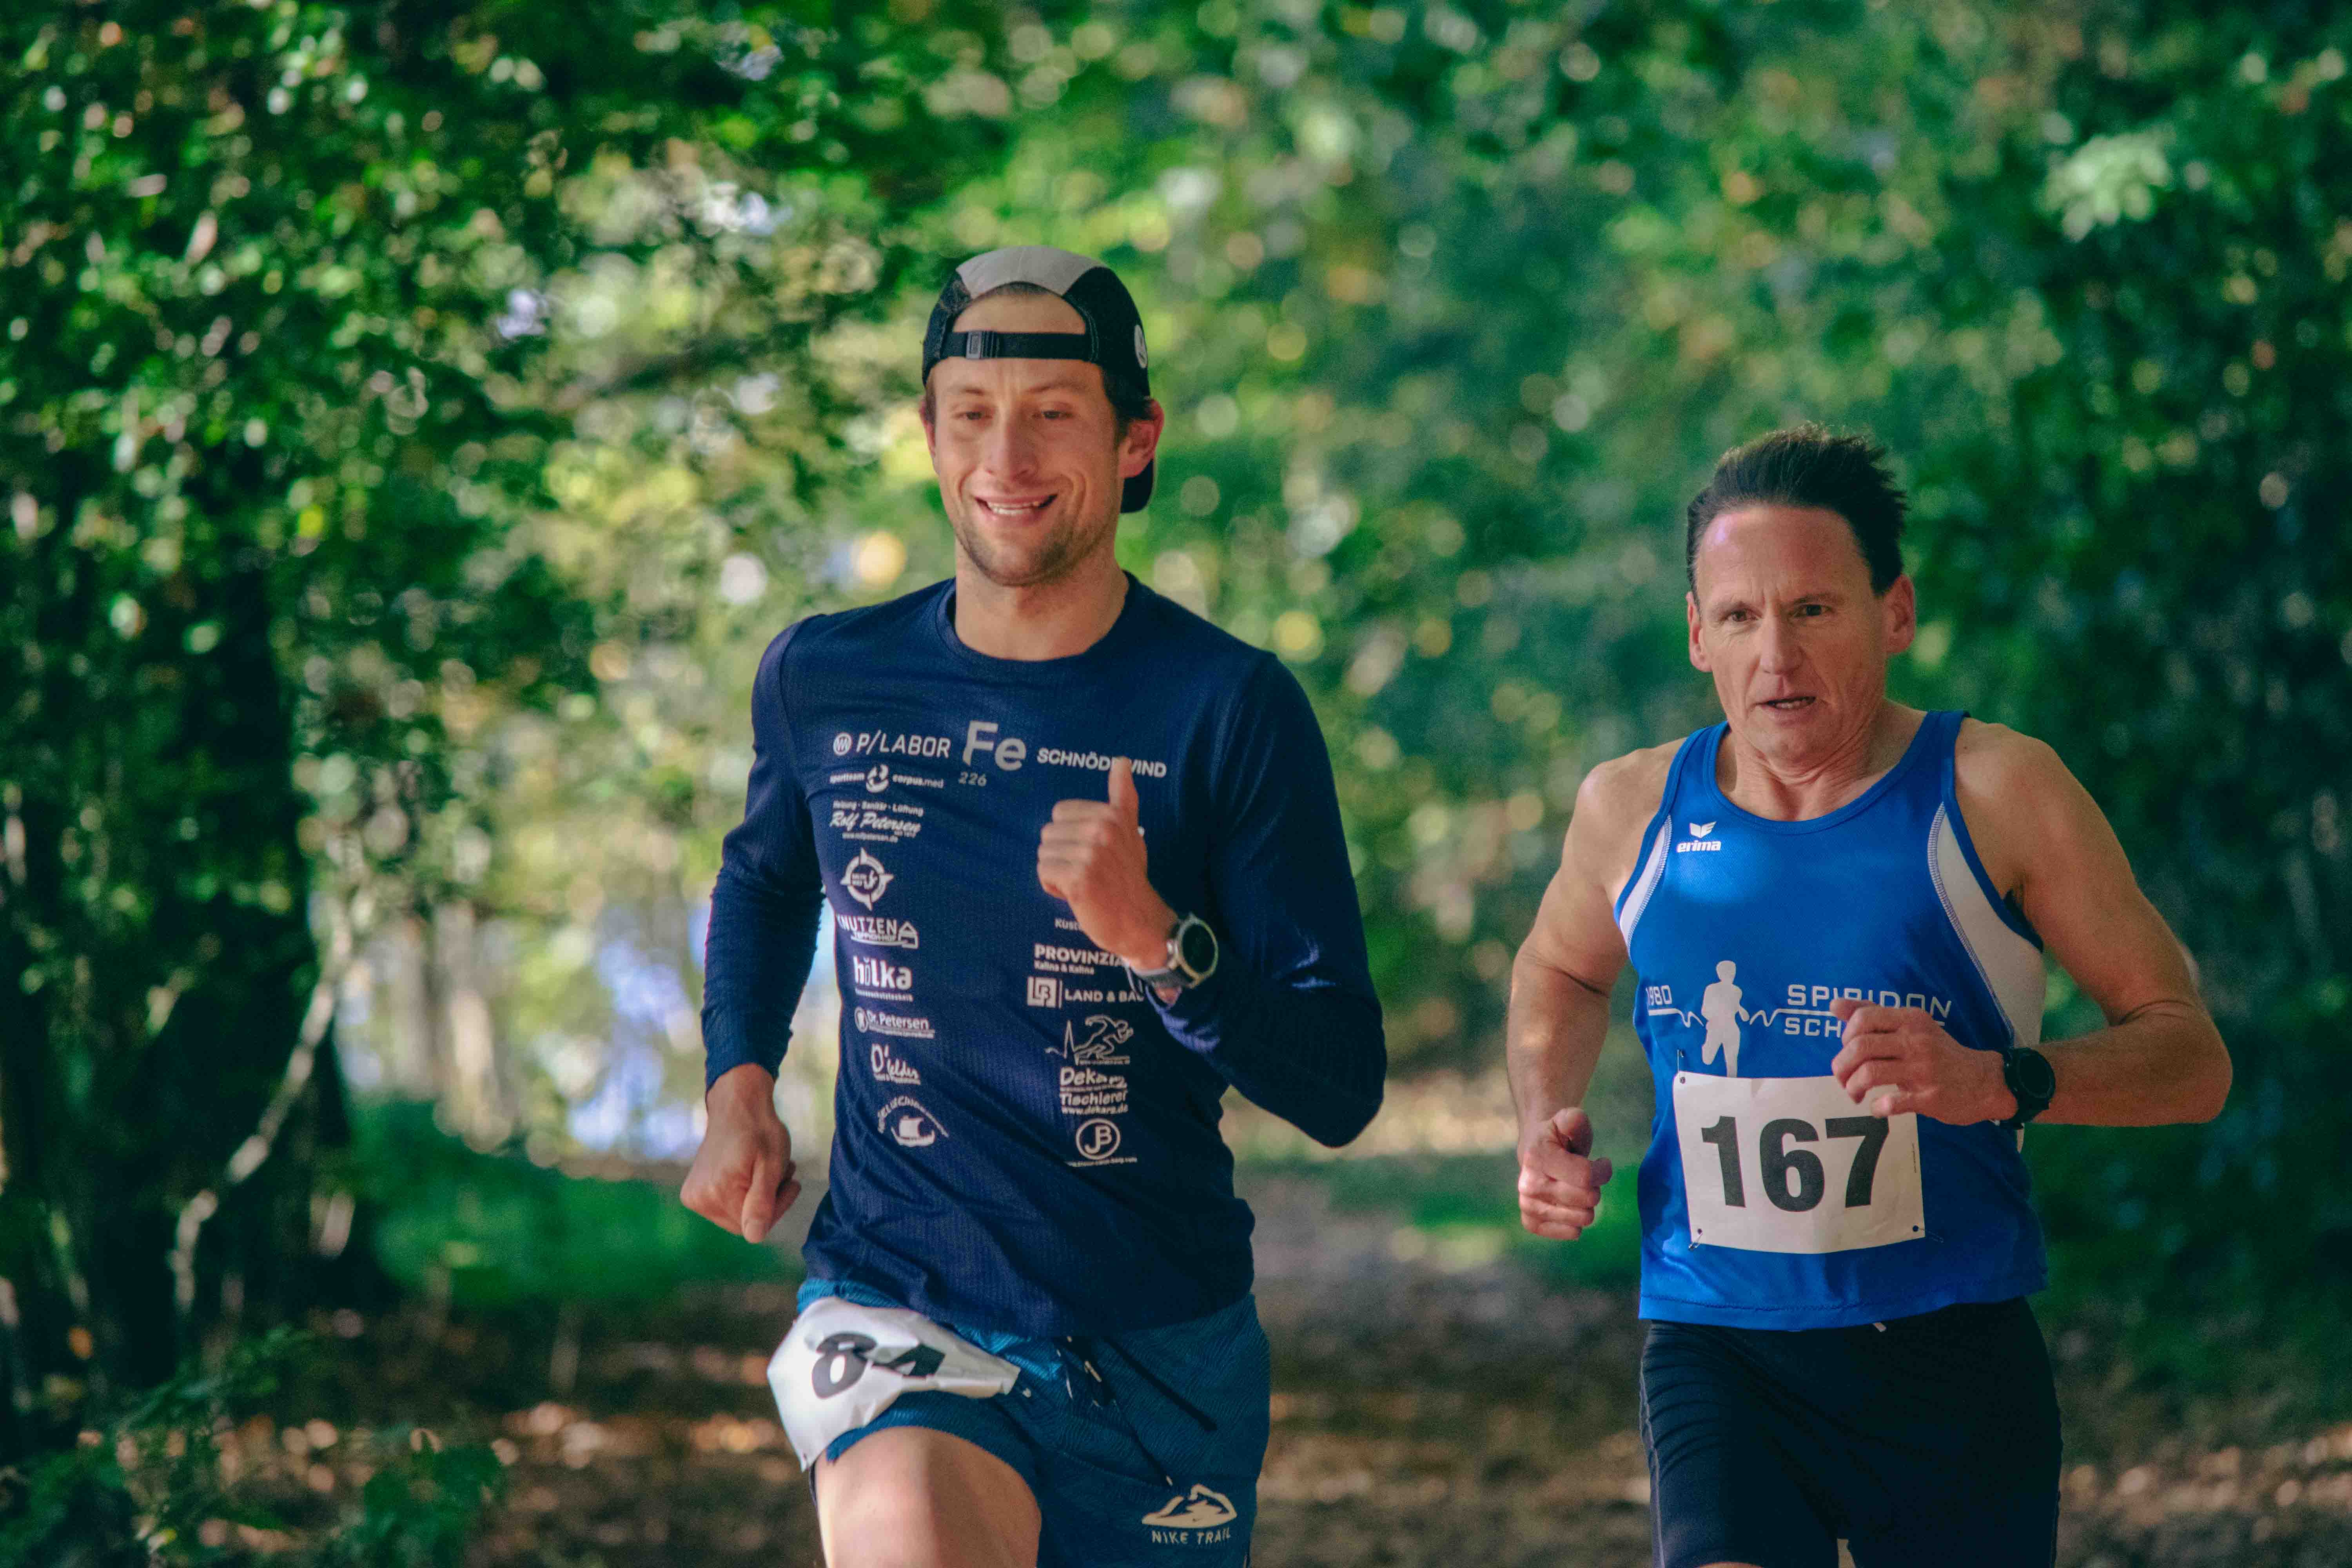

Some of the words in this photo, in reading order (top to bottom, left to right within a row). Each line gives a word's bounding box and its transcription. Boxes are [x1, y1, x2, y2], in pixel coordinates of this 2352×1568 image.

[856, 730, 951, 759] P/LABOR
[963, 720, 1027, 771] Fe
[1037, 748, 1167, 778] SCHNÖDIND
[958, 771, 987, 787] 226
[1677, 840, 1721, 853] erima
[1034, 944, 1123, 967] PROVINZIA
[1065, 989, 1103, 1002] LAND
[1106, 991, 1116, 1003] &
[1701, 1116, 1889, 1212] 167
[1151, 1530, 1189, 1544] NIKE
